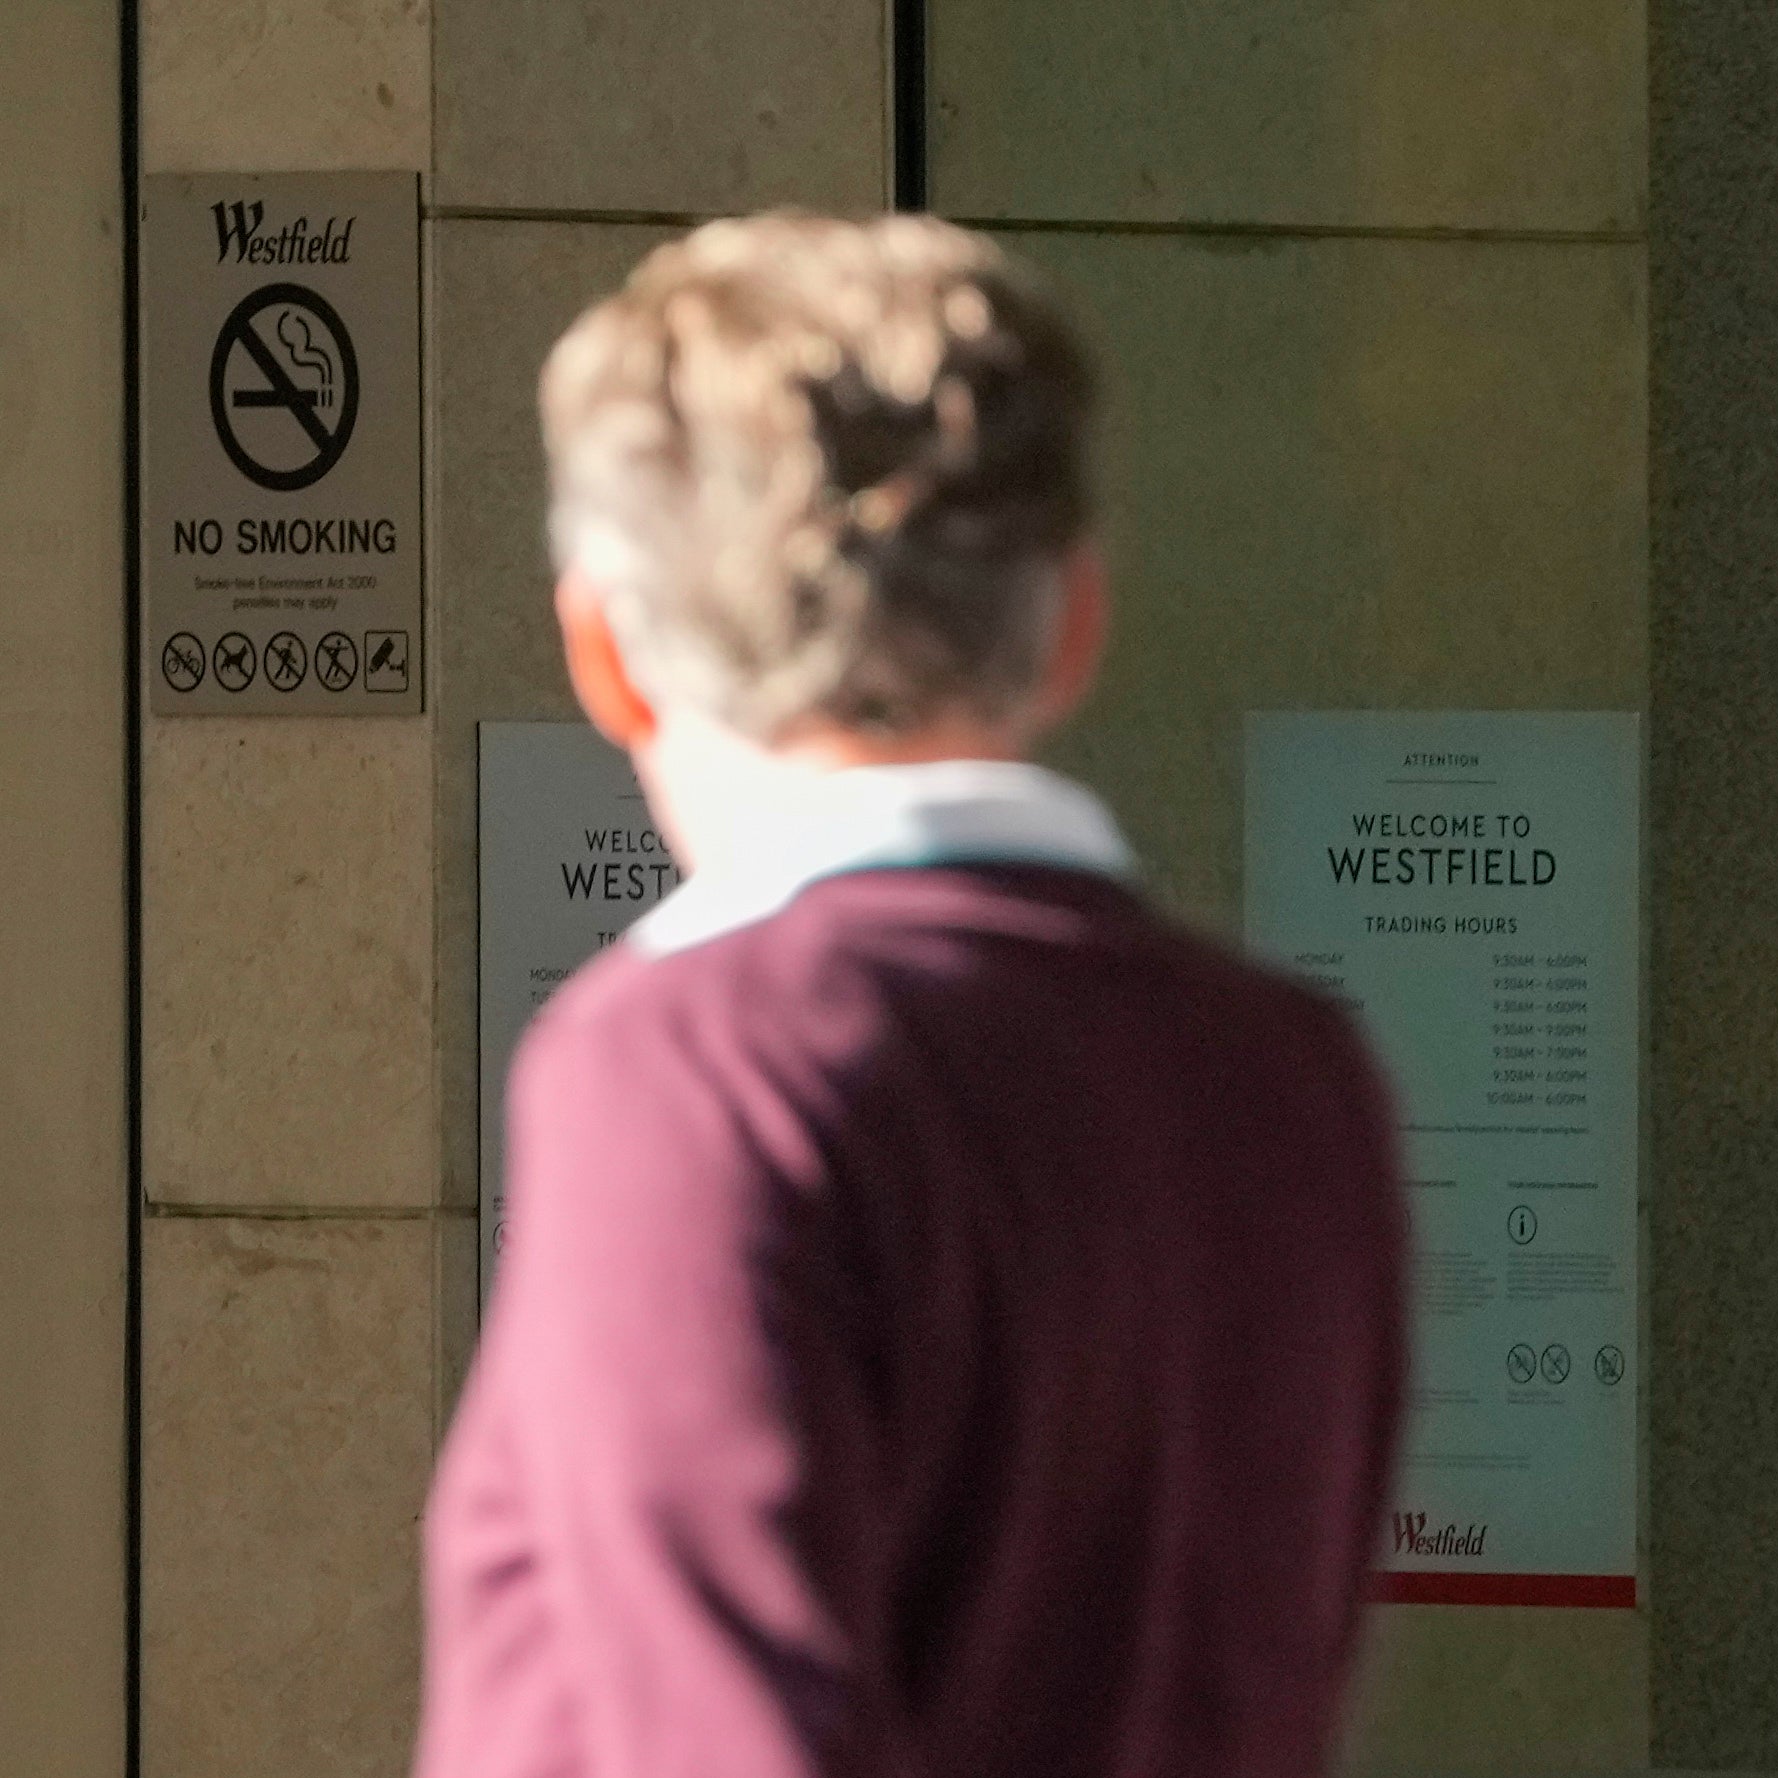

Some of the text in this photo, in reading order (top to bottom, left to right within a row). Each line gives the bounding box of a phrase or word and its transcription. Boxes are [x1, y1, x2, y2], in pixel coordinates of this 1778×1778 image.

[211, 199, 357, 265] Westfield
[174, 519, 397, 556] NO SMOKING
[1403, 754, 1480, 766] ATTENTION
[1353, 814, 1531, 838] WELCOME TO
[561, 862, 681, 901] WEST
[1328, 846, 1557, 886] WESTFIELD
[1364, 917, 1519, 935] TRADING HOURS
